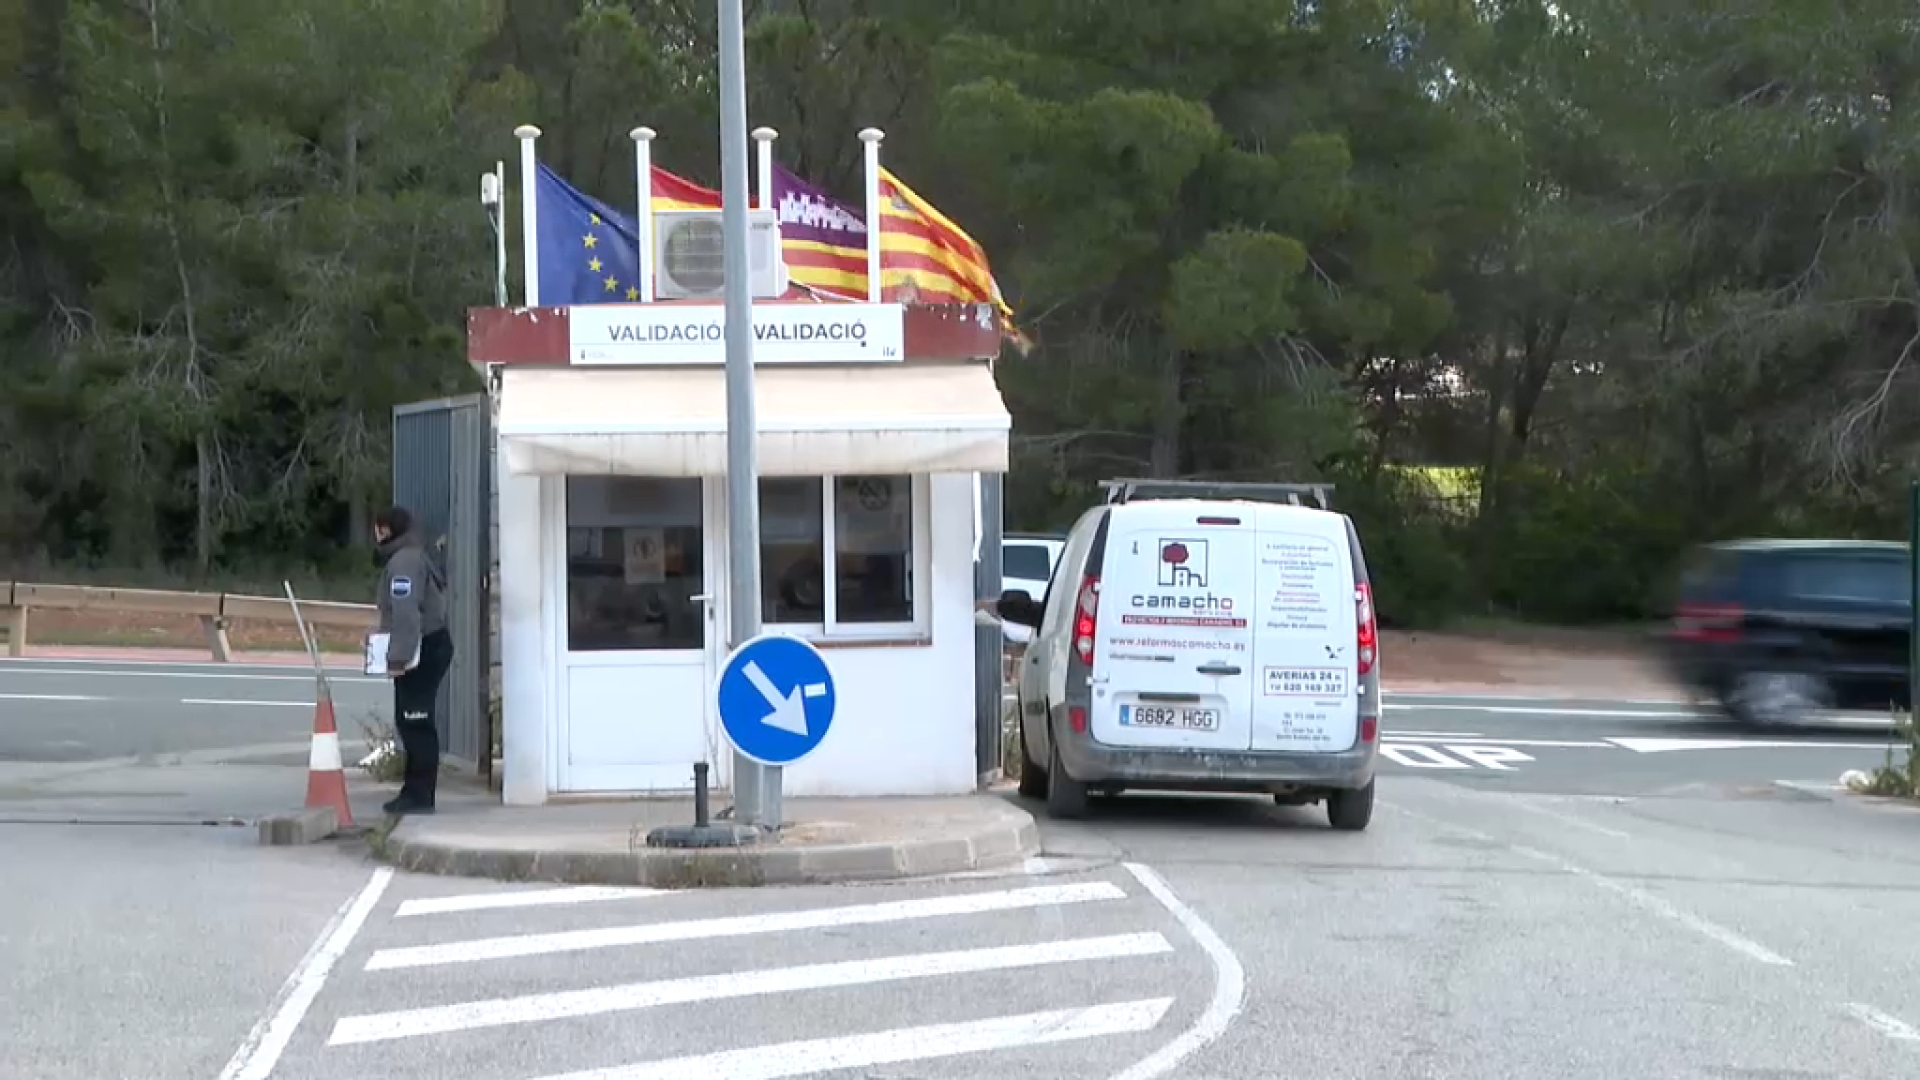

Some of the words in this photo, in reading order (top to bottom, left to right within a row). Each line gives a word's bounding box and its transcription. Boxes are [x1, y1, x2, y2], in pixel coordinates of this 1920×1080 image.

[608, 319, 726, 342] VALIDACIÓ
[753, 318, 867, 340] VALIDACIÓ
[1131, 592, 1233, 610] camacho
[1269, 670, 1317, 681] AVERIAS
[1319, 671, 1332, 681] 24
[1182, 710, 1213, 728] HGG
